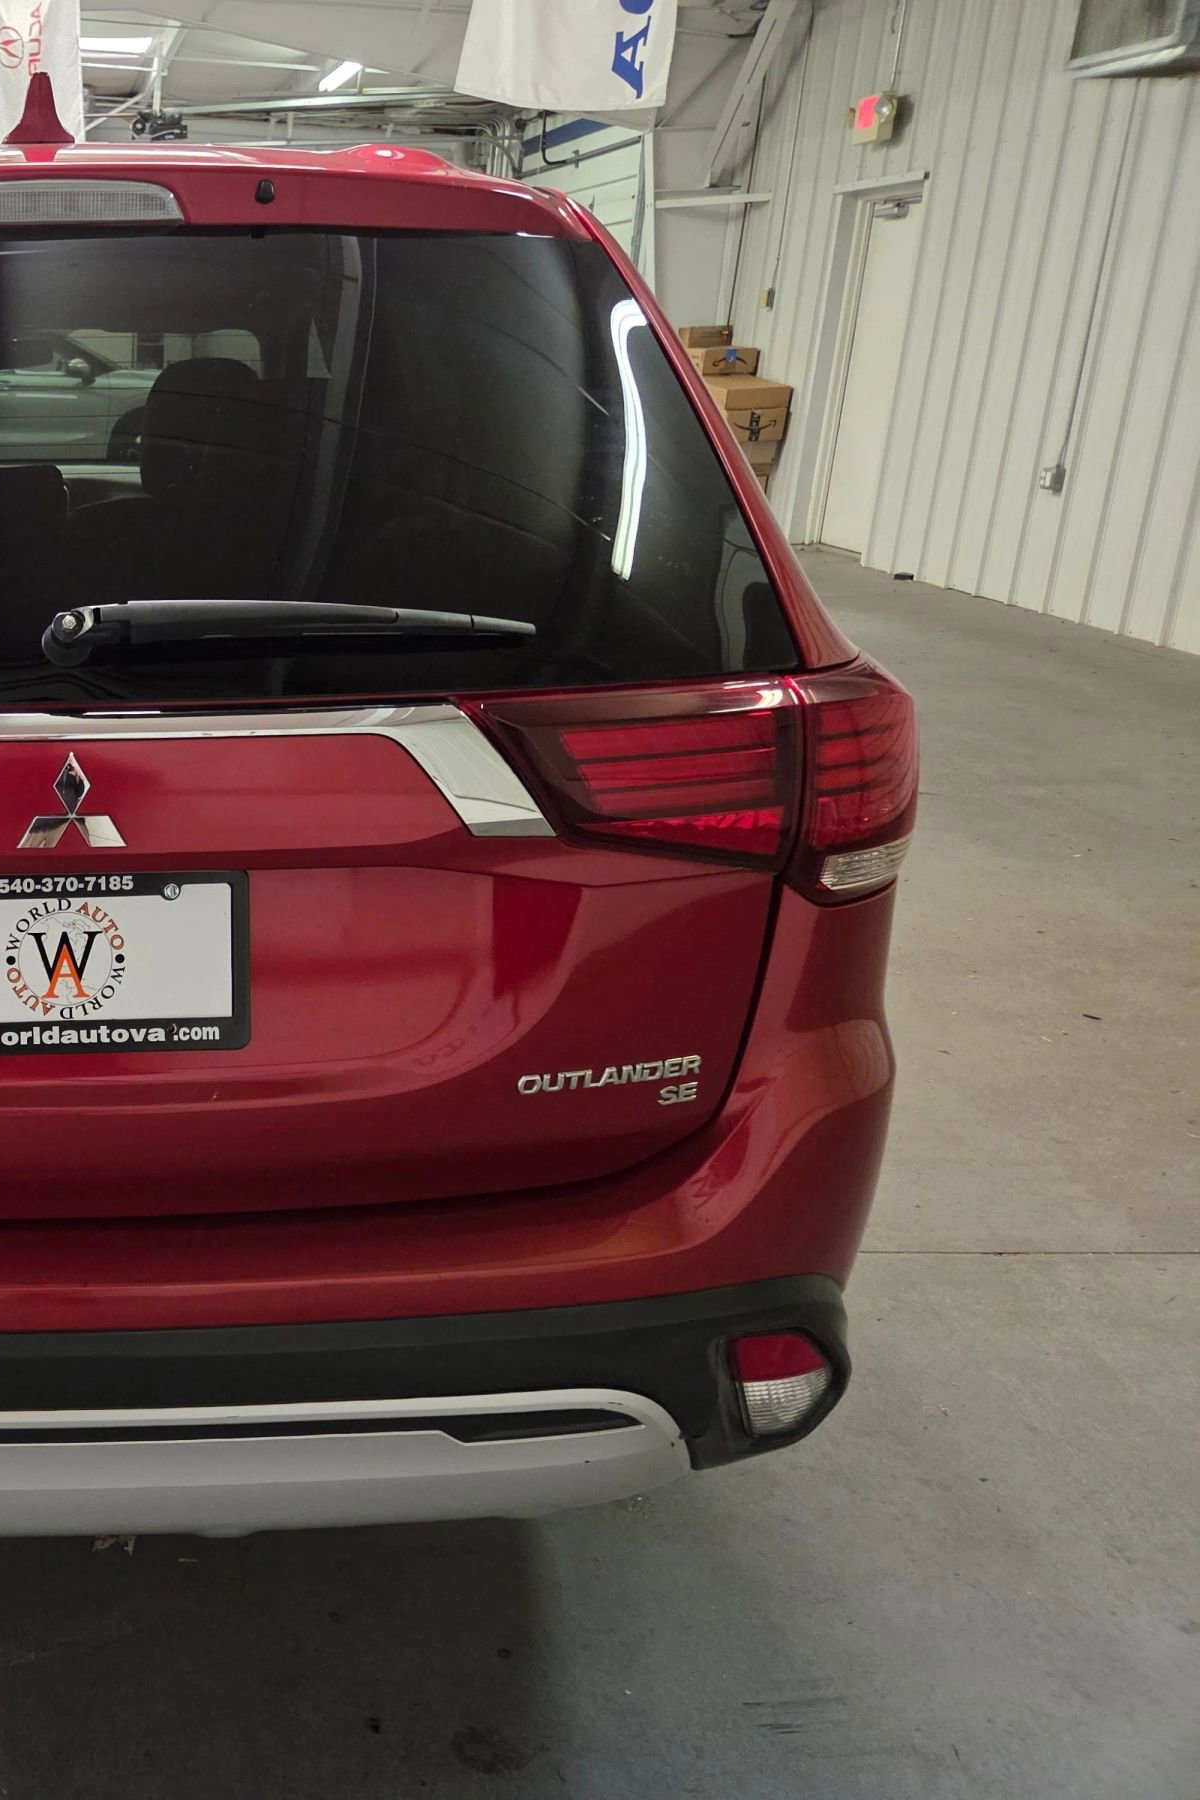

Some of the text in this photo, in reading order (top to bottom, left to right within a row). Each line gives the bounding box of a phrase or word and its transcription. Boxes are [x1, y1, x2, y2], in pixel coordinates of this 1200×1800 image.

[6, 898, 125, 952] WORLD AUTO
[517, 1054, 702, 1096] OUTLANDER
[656, 1081, 699, 1106] SE
